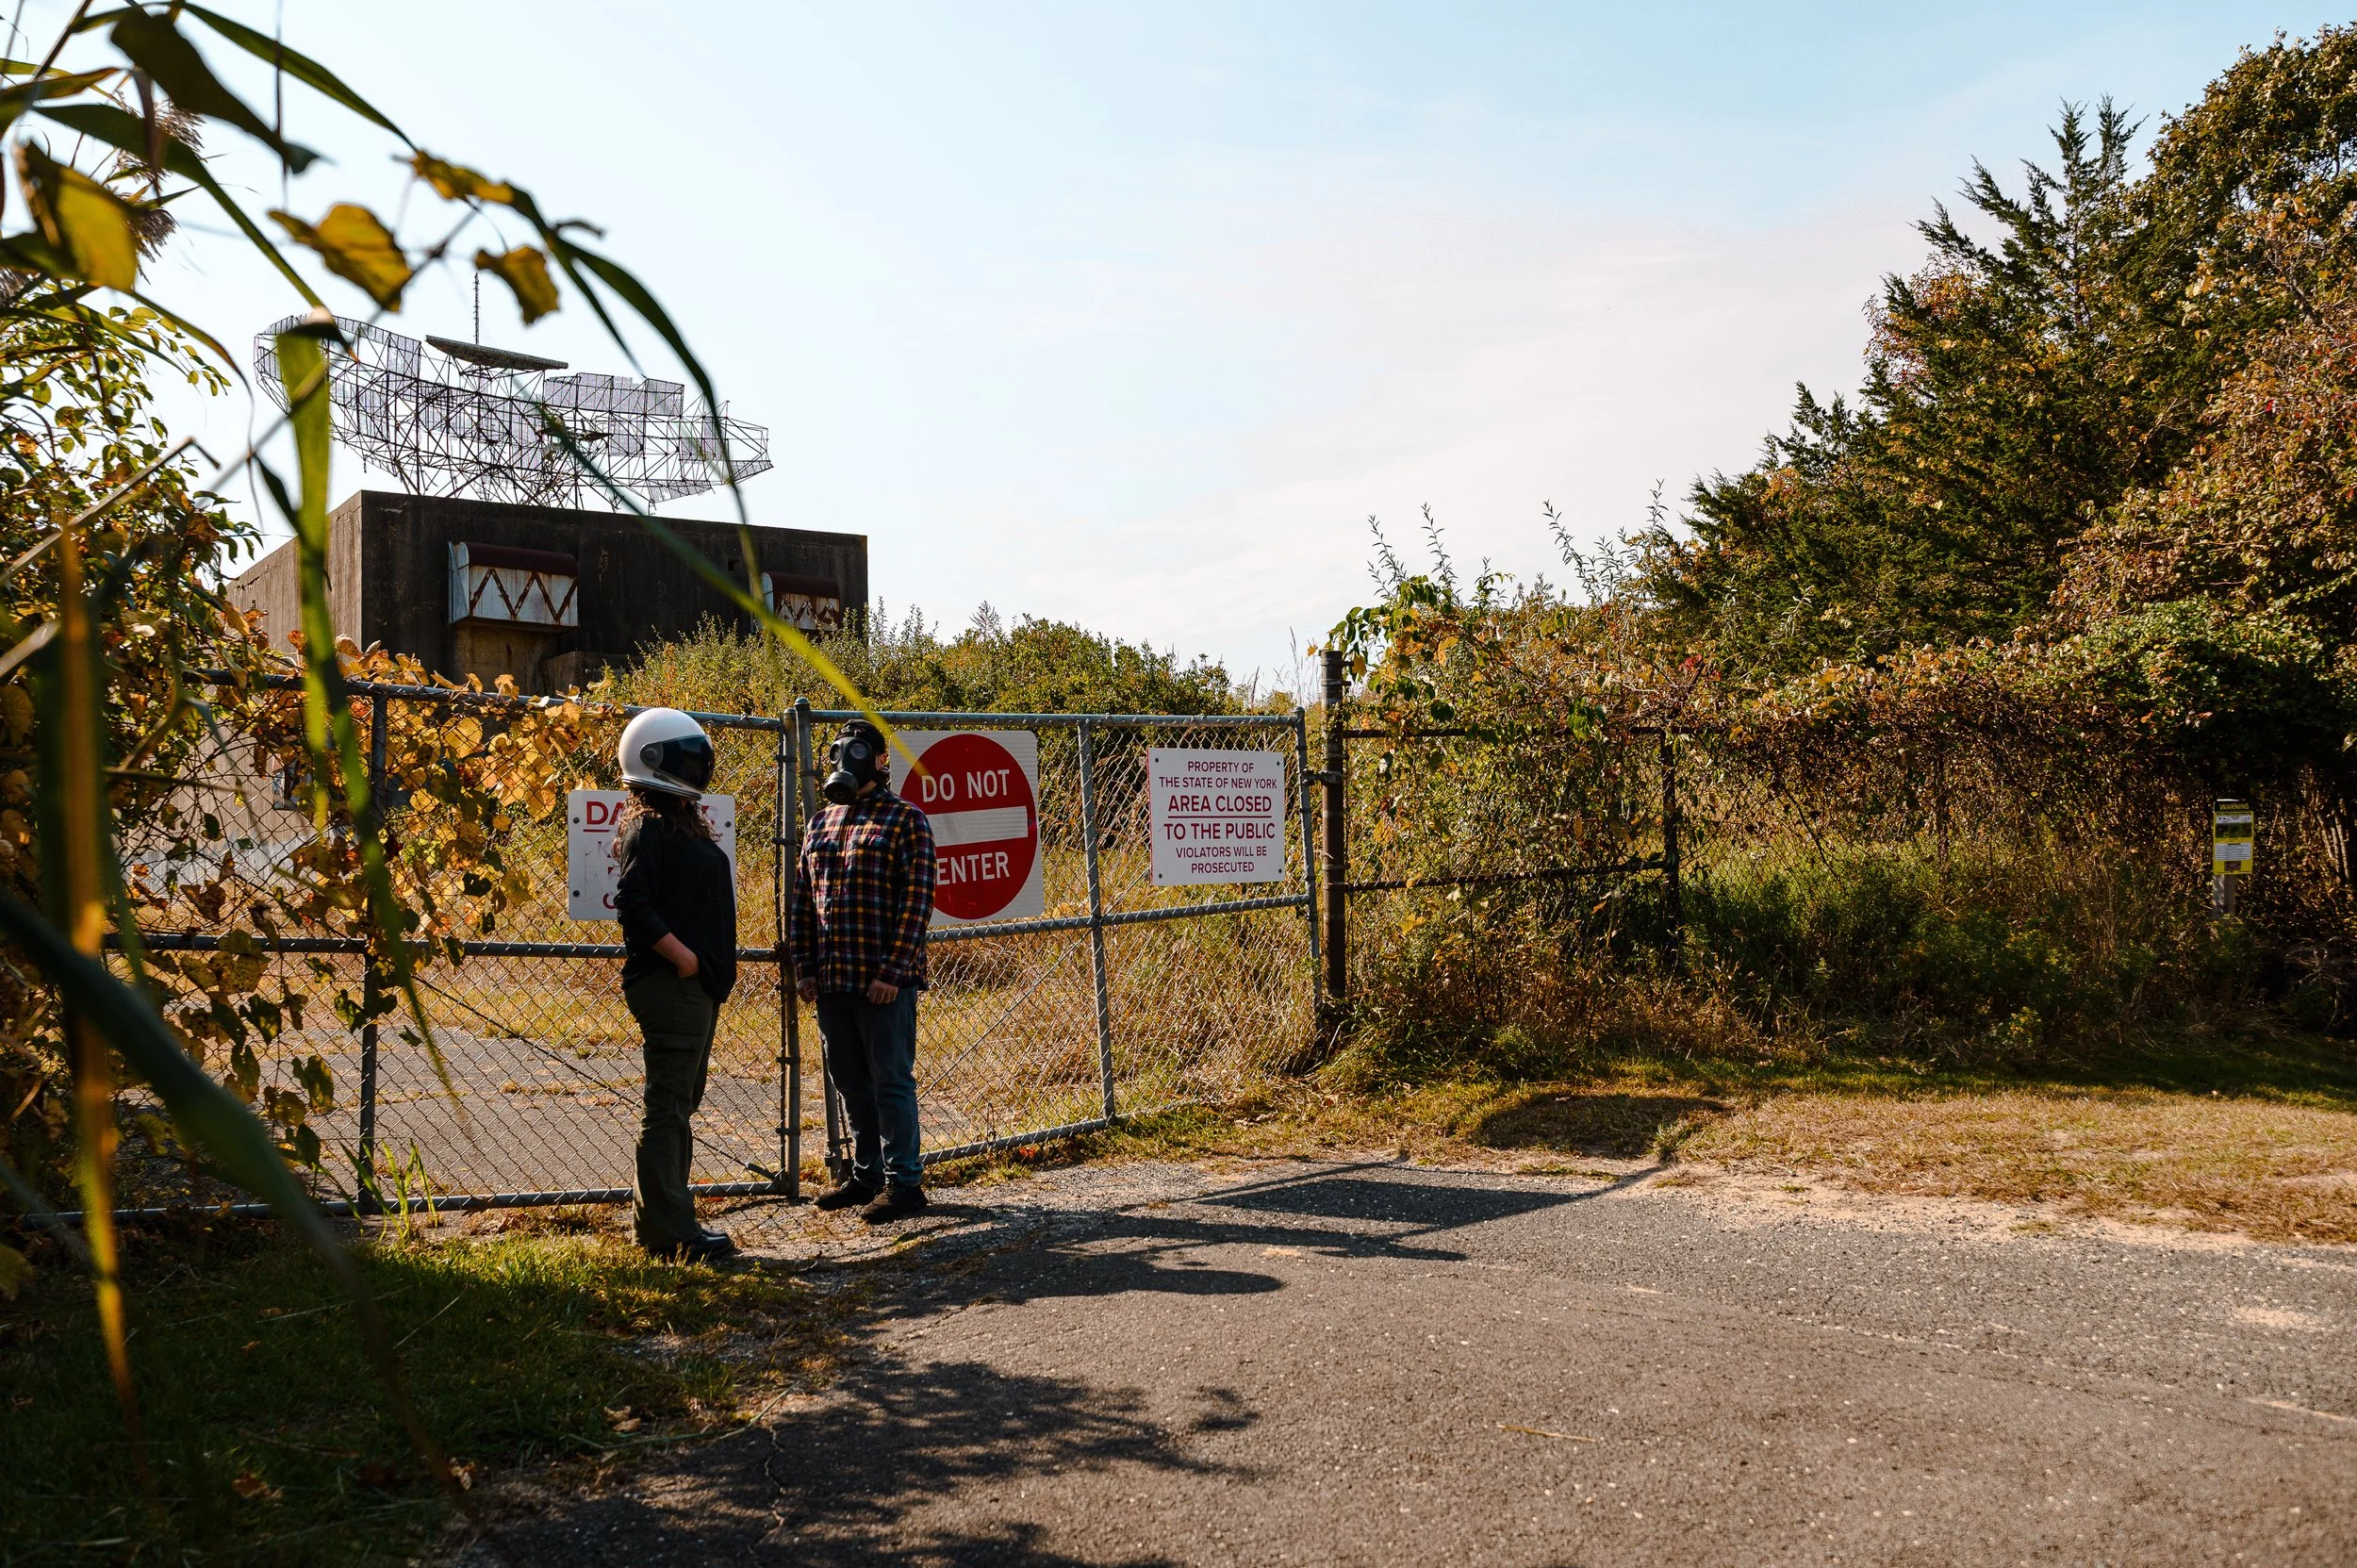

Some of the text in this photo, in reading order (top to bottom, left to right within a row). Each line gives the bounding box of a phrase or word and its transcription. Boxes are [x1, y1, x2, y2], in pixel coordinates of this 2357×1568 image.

[1188, 761, 1254, 773] PROPERTY OF
[921, 768, 1010, 802] DO NOT
[1159, 777, 1277, 789] THE STATE OF NEW YORK
[1168, 795, 1272, 812] AREA CLOSED
[1163, 822, 1276, 840] TO THE PUBLIC
[1176, 846, 1267, 858] VIOLATORS WILL BE
[936, 851, 1010, 885] ENTER
[1192, 862, 1255, 874] PROSECUTED
